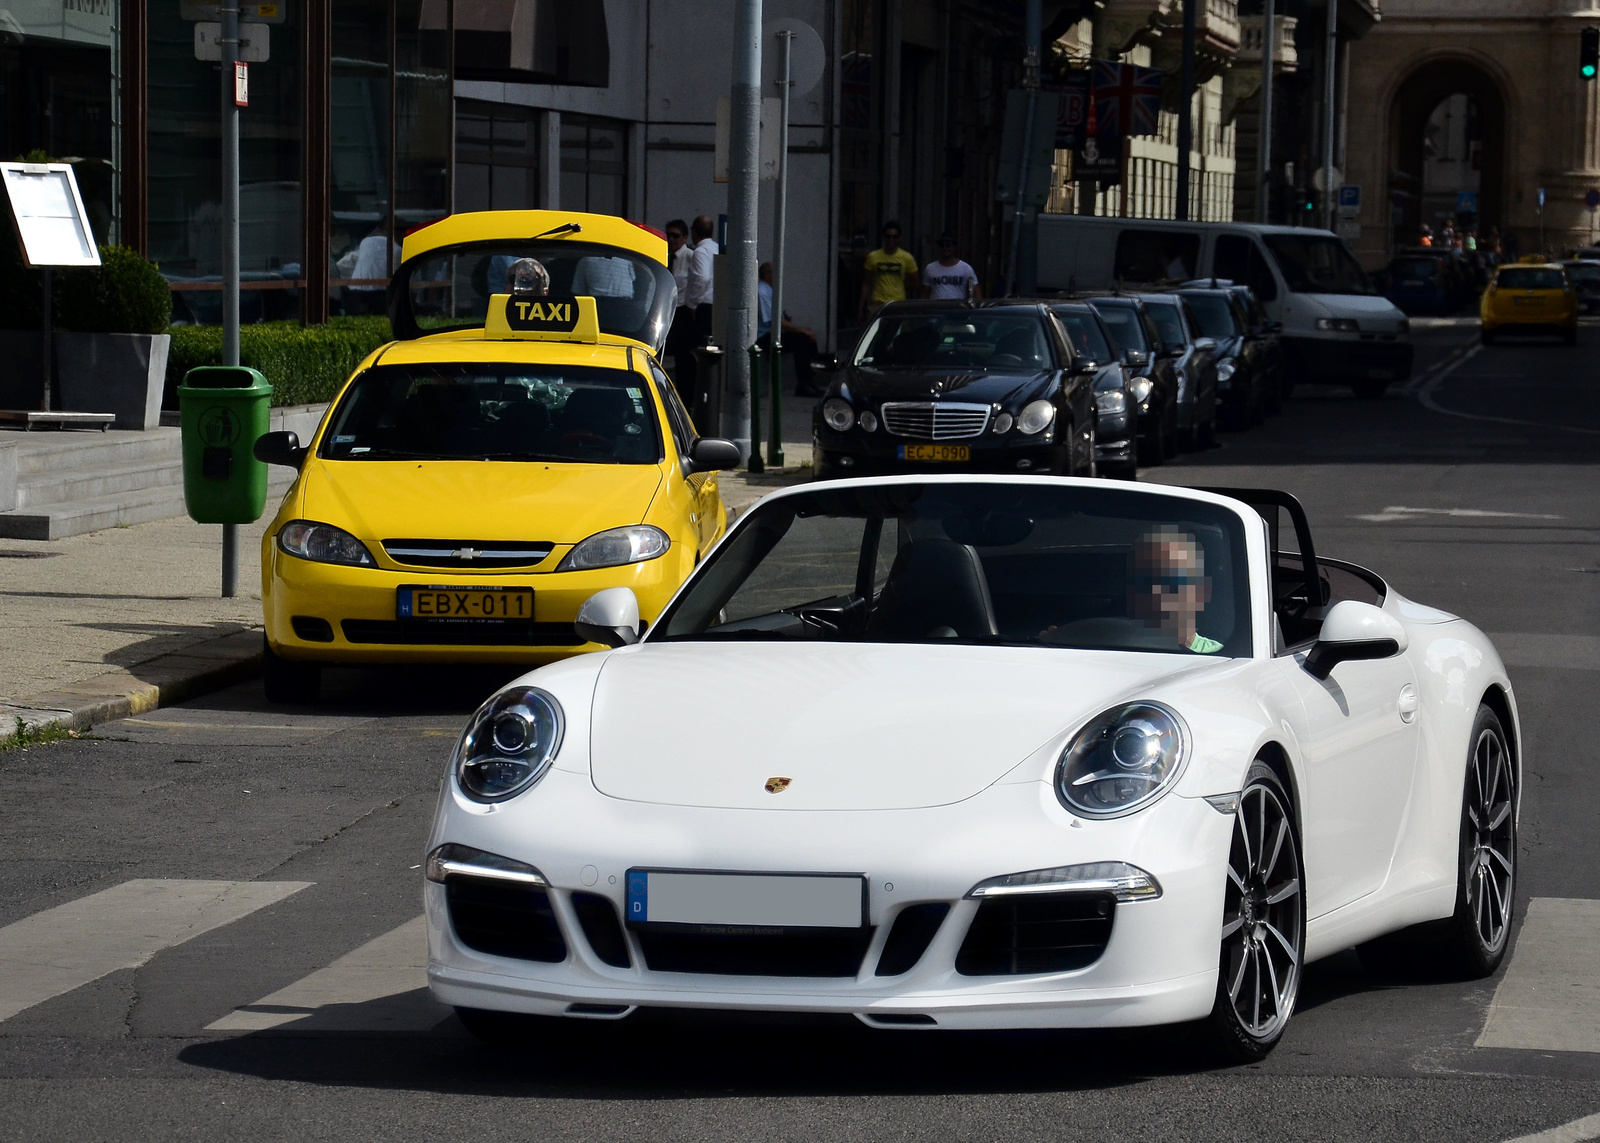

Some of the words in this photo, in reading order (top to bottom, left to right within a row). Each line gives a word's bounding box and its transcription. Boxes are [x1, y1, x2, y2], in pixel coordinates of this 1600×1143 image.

[514, 301, 571, 322] TAXI
[906, 446, 967, 459] ECJ-090
[401, 605, 409, 613] H
[417, 593, 524, 616] EBX-011
[633, 902, 642, 912] D
[700, 925, 726, 934] Porsche
[727, 926, 754, 934] Centrum
[754, 927, 784, 936] Budapest
